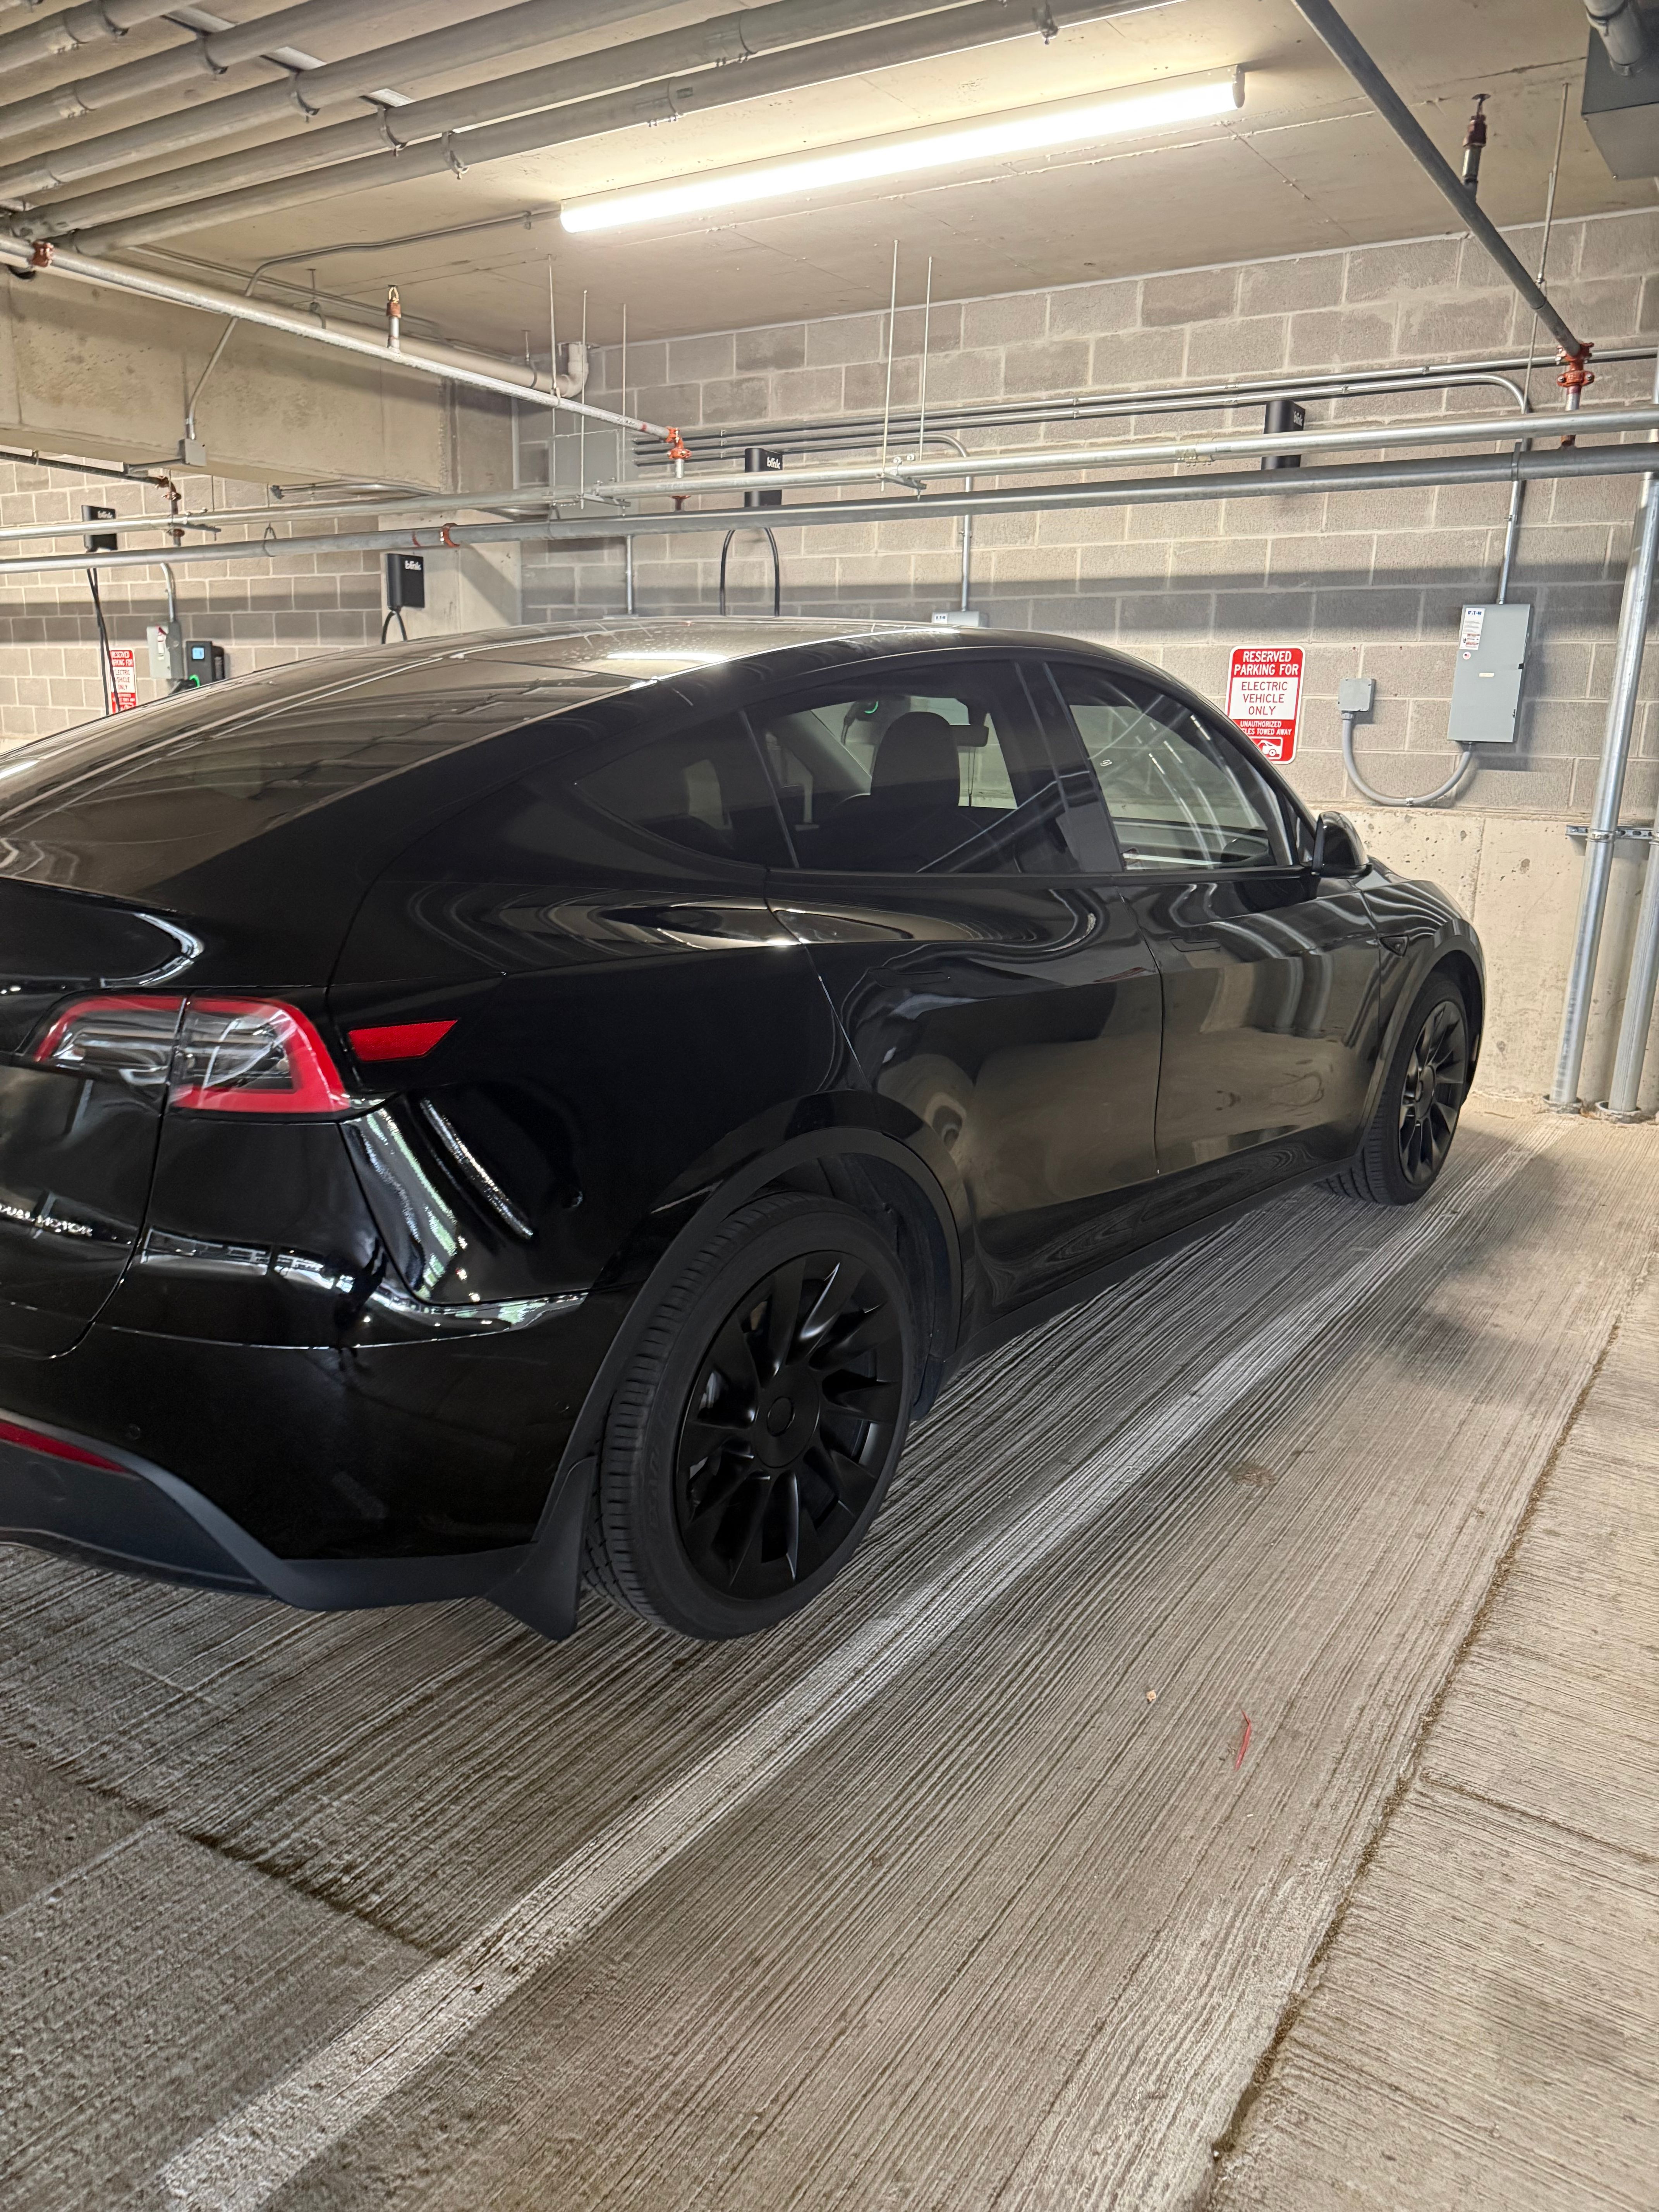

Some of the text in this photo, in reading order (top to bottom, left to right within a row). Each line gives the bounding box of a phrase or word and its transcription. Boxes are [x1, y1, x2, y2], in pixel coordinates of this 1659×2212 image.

[767, 457, 780, 469] blink
[1243, 651, 1292, 662] RESERVED
[1234, 664, 1299, 675] PARKING FOR
[1242, 682, 1288, 691] ELECTRIC
[1243, 694, 1285, 703] VEHICLE
[1249, 706, 1276, 715] ONLY
